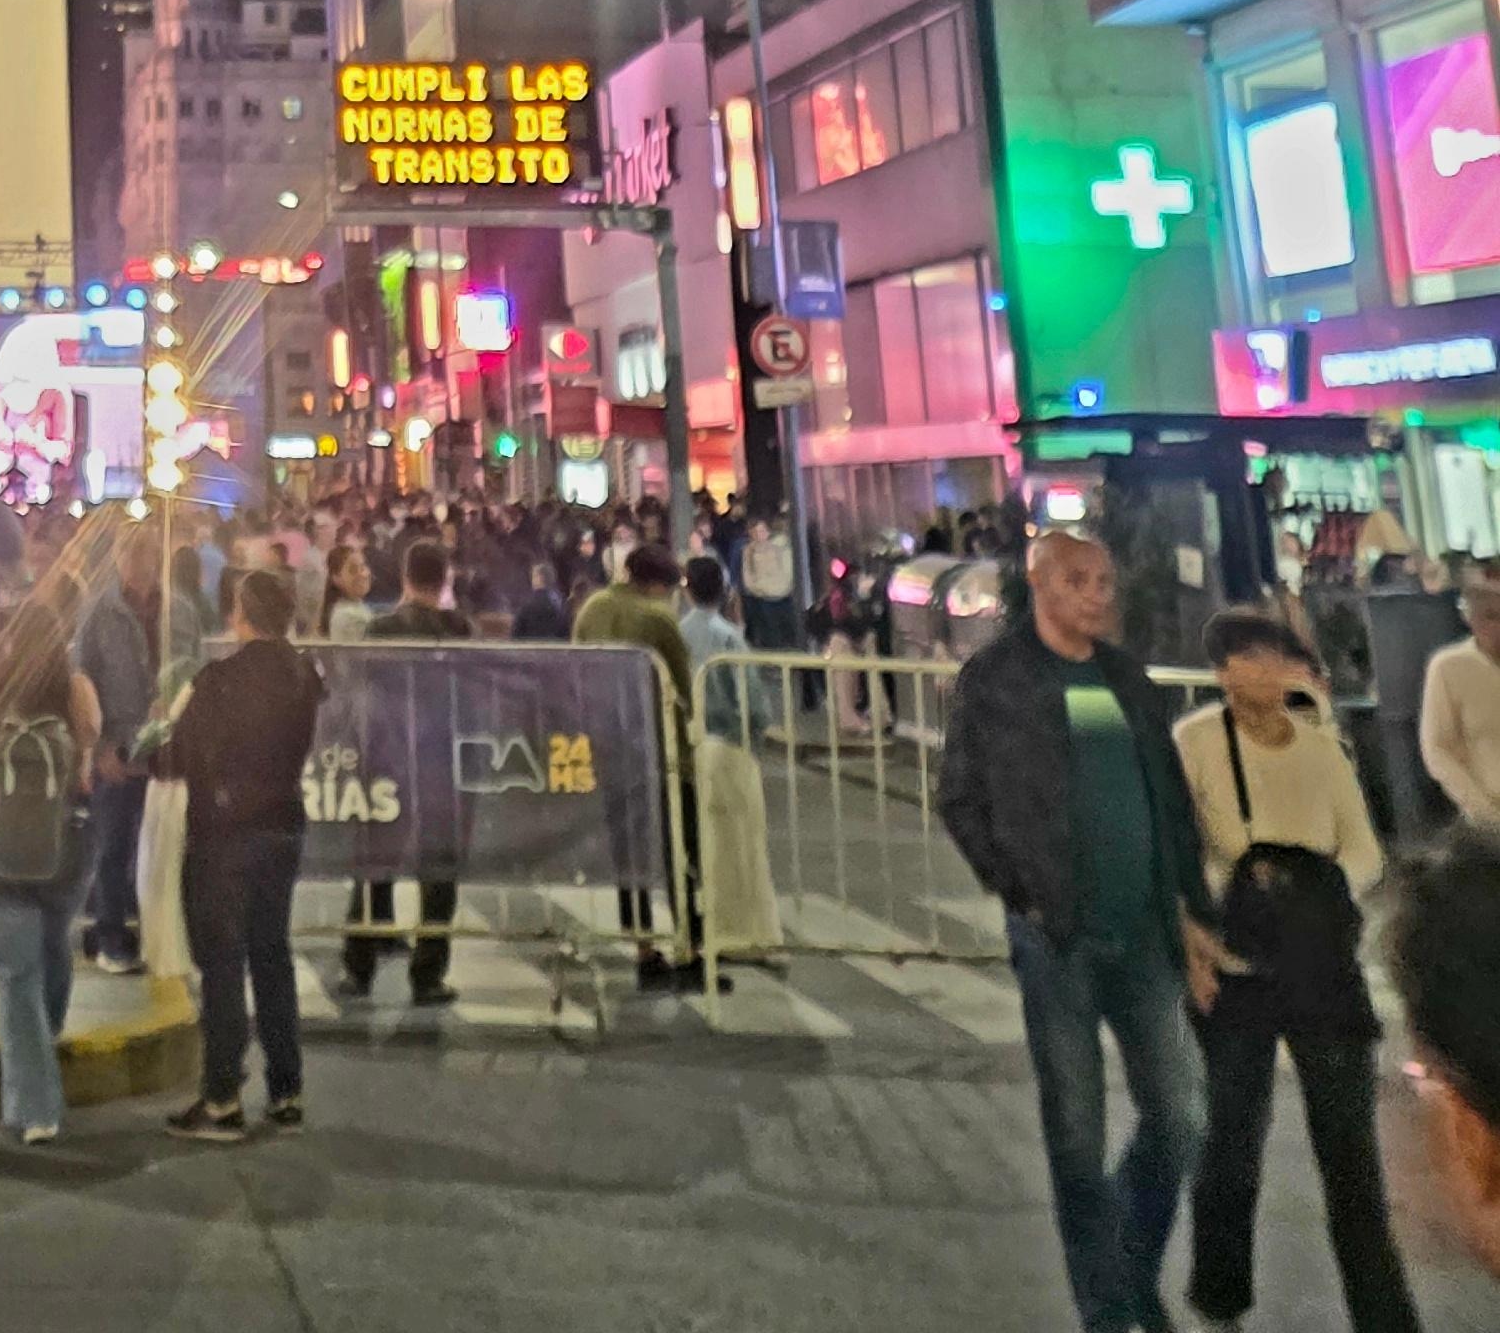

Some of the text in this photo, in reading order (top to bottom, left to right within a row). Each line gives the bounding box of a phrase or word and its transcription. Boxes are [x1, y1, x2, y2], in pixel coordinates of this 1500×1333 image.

[341, 65, 589, 102] CUMPLI LAS
[342, 106, 568, 143] NORMAS DE
[370, 148, 570, 185] TRANSITO
